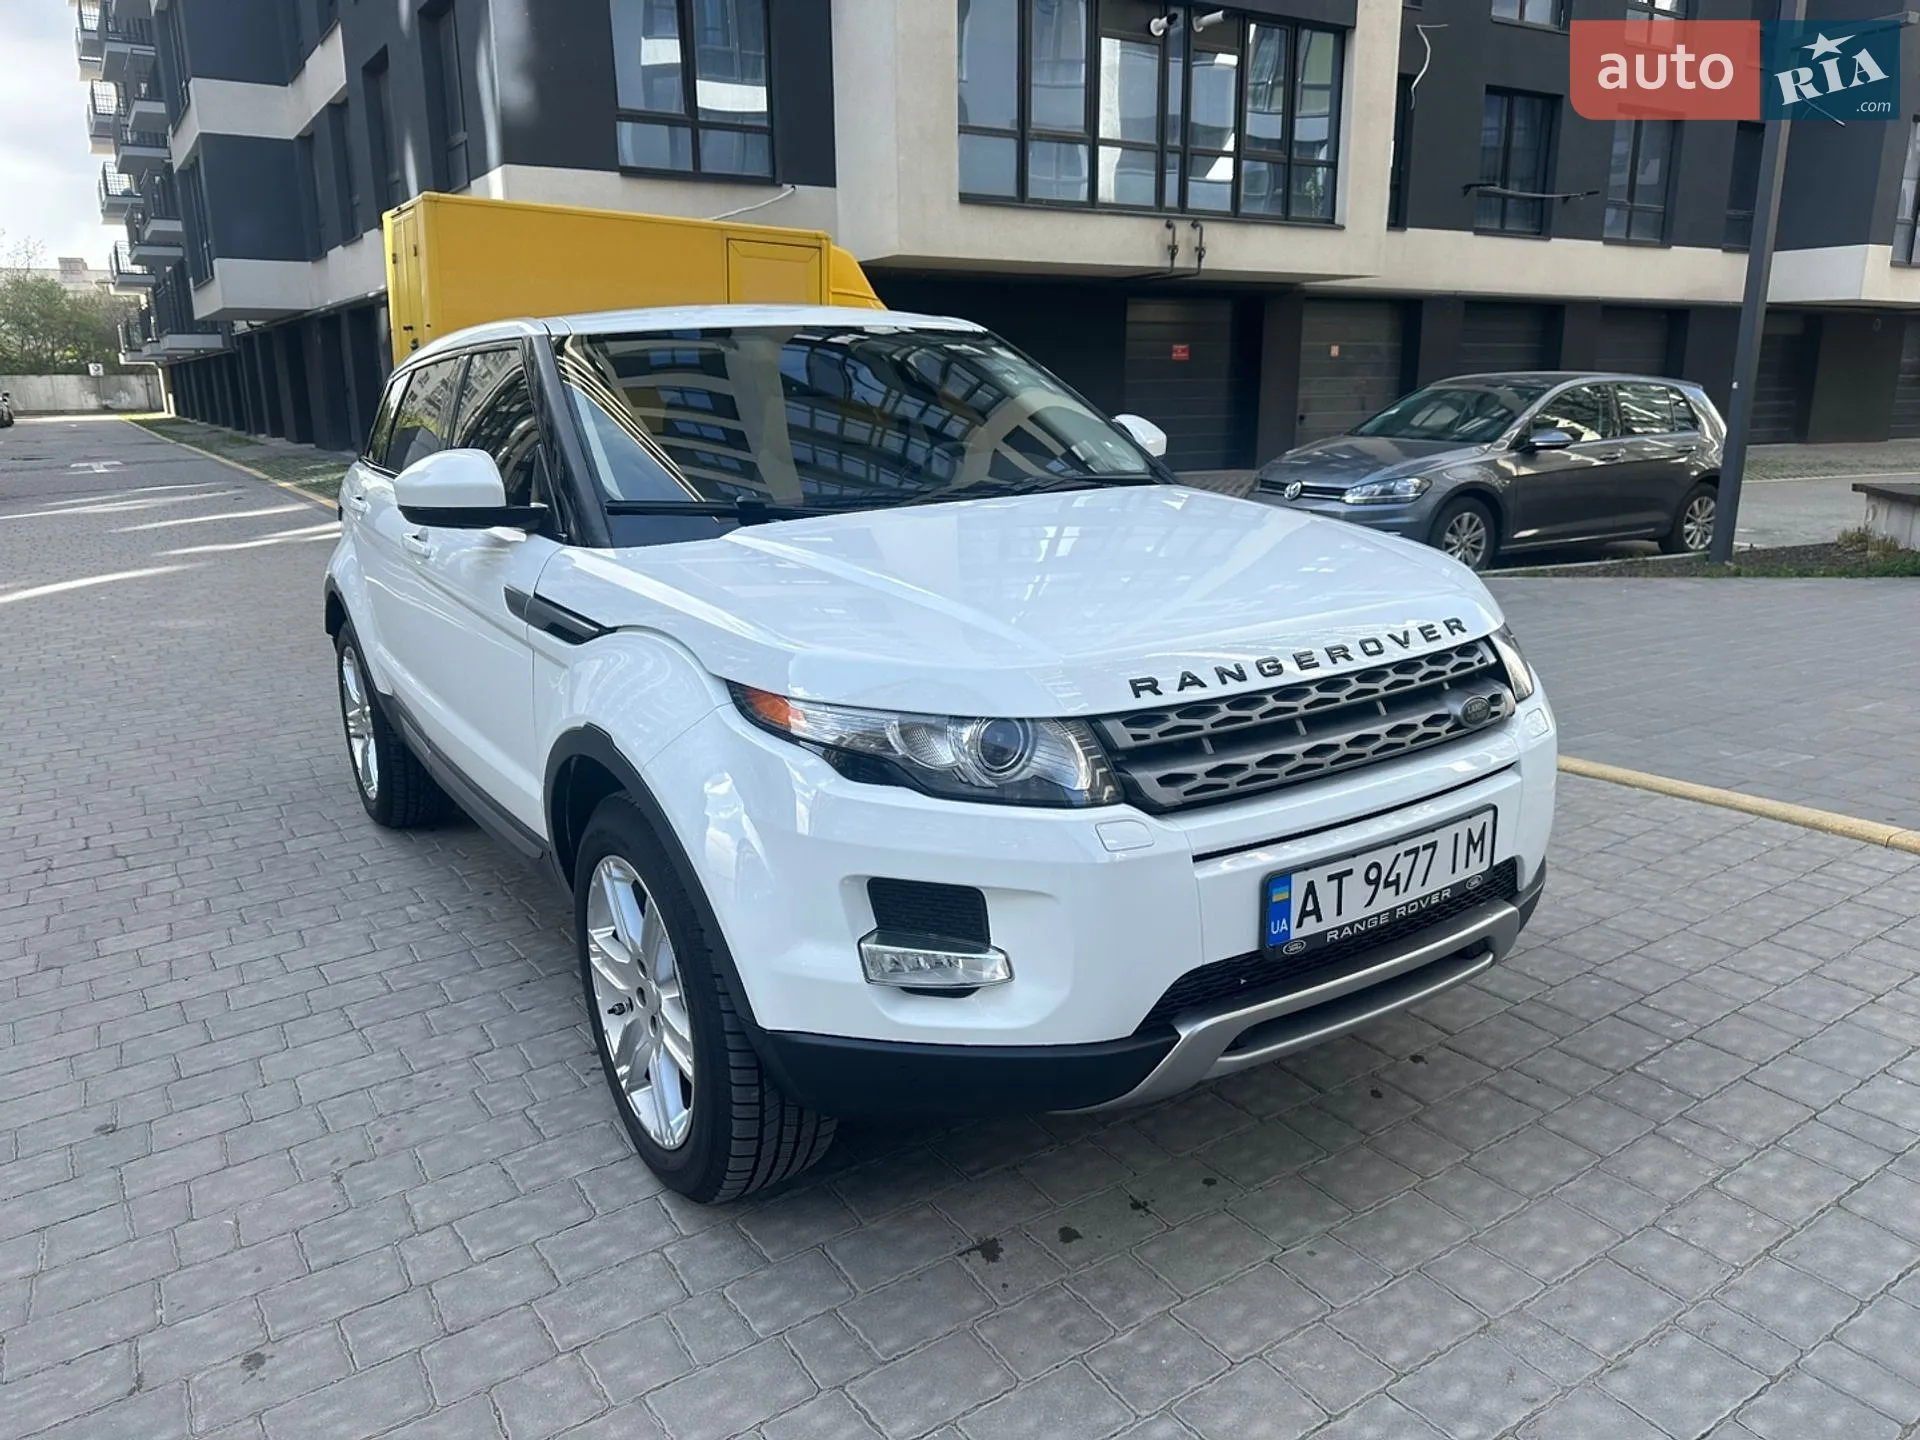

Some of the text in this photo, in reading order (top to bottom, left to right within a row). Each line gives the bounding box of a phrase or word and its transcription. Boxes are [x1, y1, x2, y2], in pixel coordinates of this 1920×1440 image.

[1295, 821, 1487, 929] AT 9477 IM
[1271, 919, 1289, 934] UA
[1326, 888, 1451, 943] RANGE ROVER
